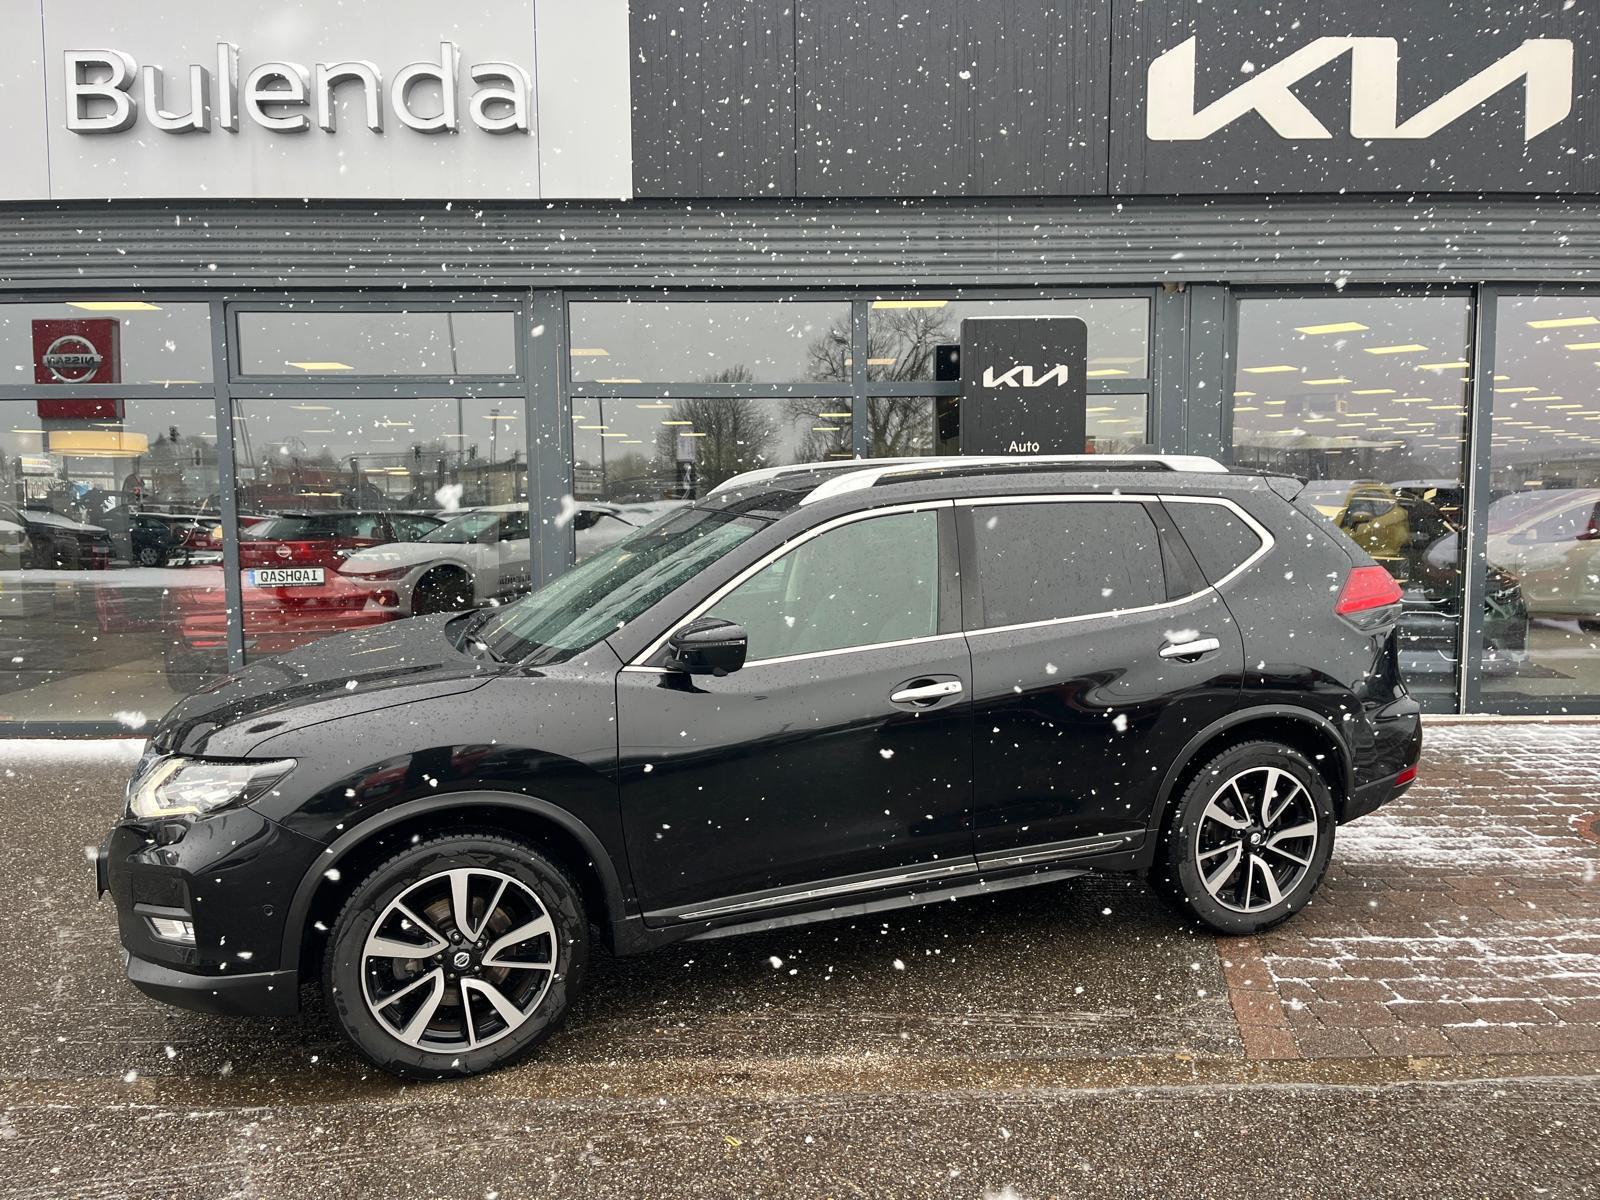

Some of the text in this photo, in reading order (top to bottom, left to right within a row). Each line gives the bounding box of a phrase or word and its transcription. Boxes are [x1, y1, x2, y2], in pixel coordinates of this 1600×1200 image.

[63, 41, 530, 134] Bulenda
[1146, 35, 1574, 141] KIA
[983, 365, 1068, 388] KIA
[1008, 440, 1040, 453] Auto
[260, 569, 318, 583] QASHQAI
